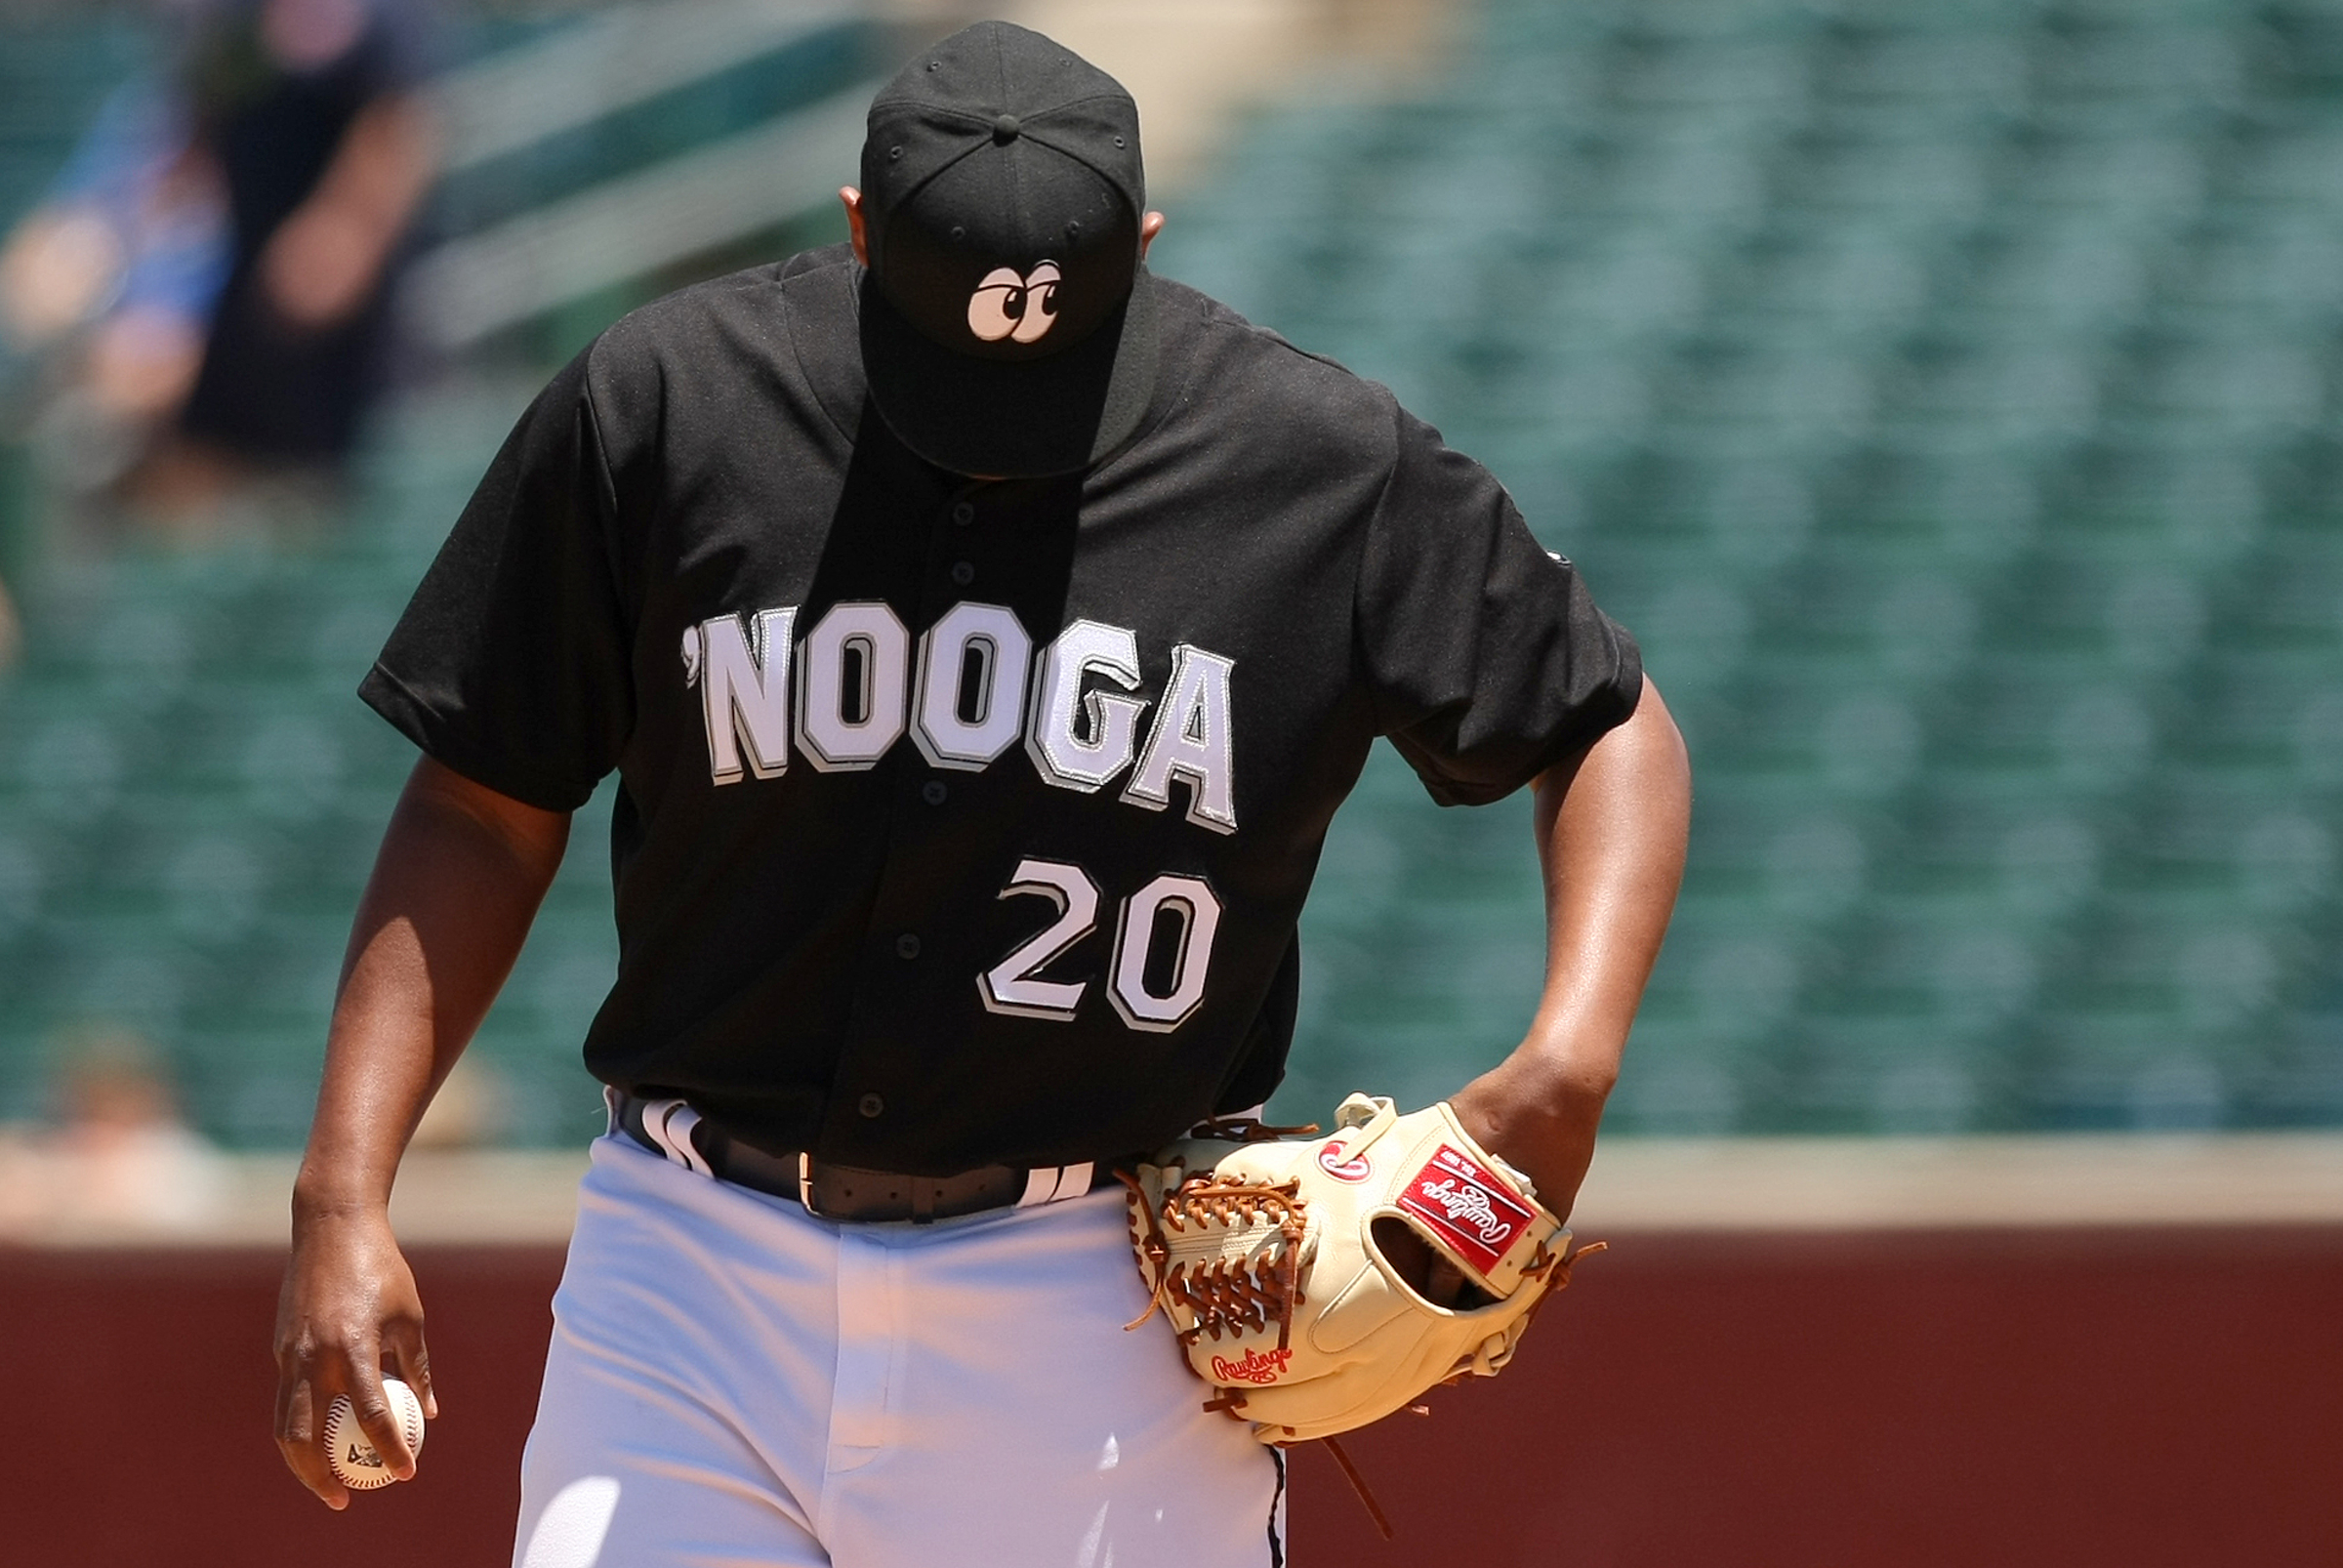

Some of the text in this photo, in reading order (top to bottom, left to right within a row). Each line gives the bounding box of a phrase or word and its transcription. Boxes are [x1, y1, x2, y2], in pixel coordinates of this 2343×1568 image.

[680, 599, 1238, 835] 'NOOGA
[976, 856, 1224, 1033] 20
[1421, 1179, 1511, 1244] Rawlings
